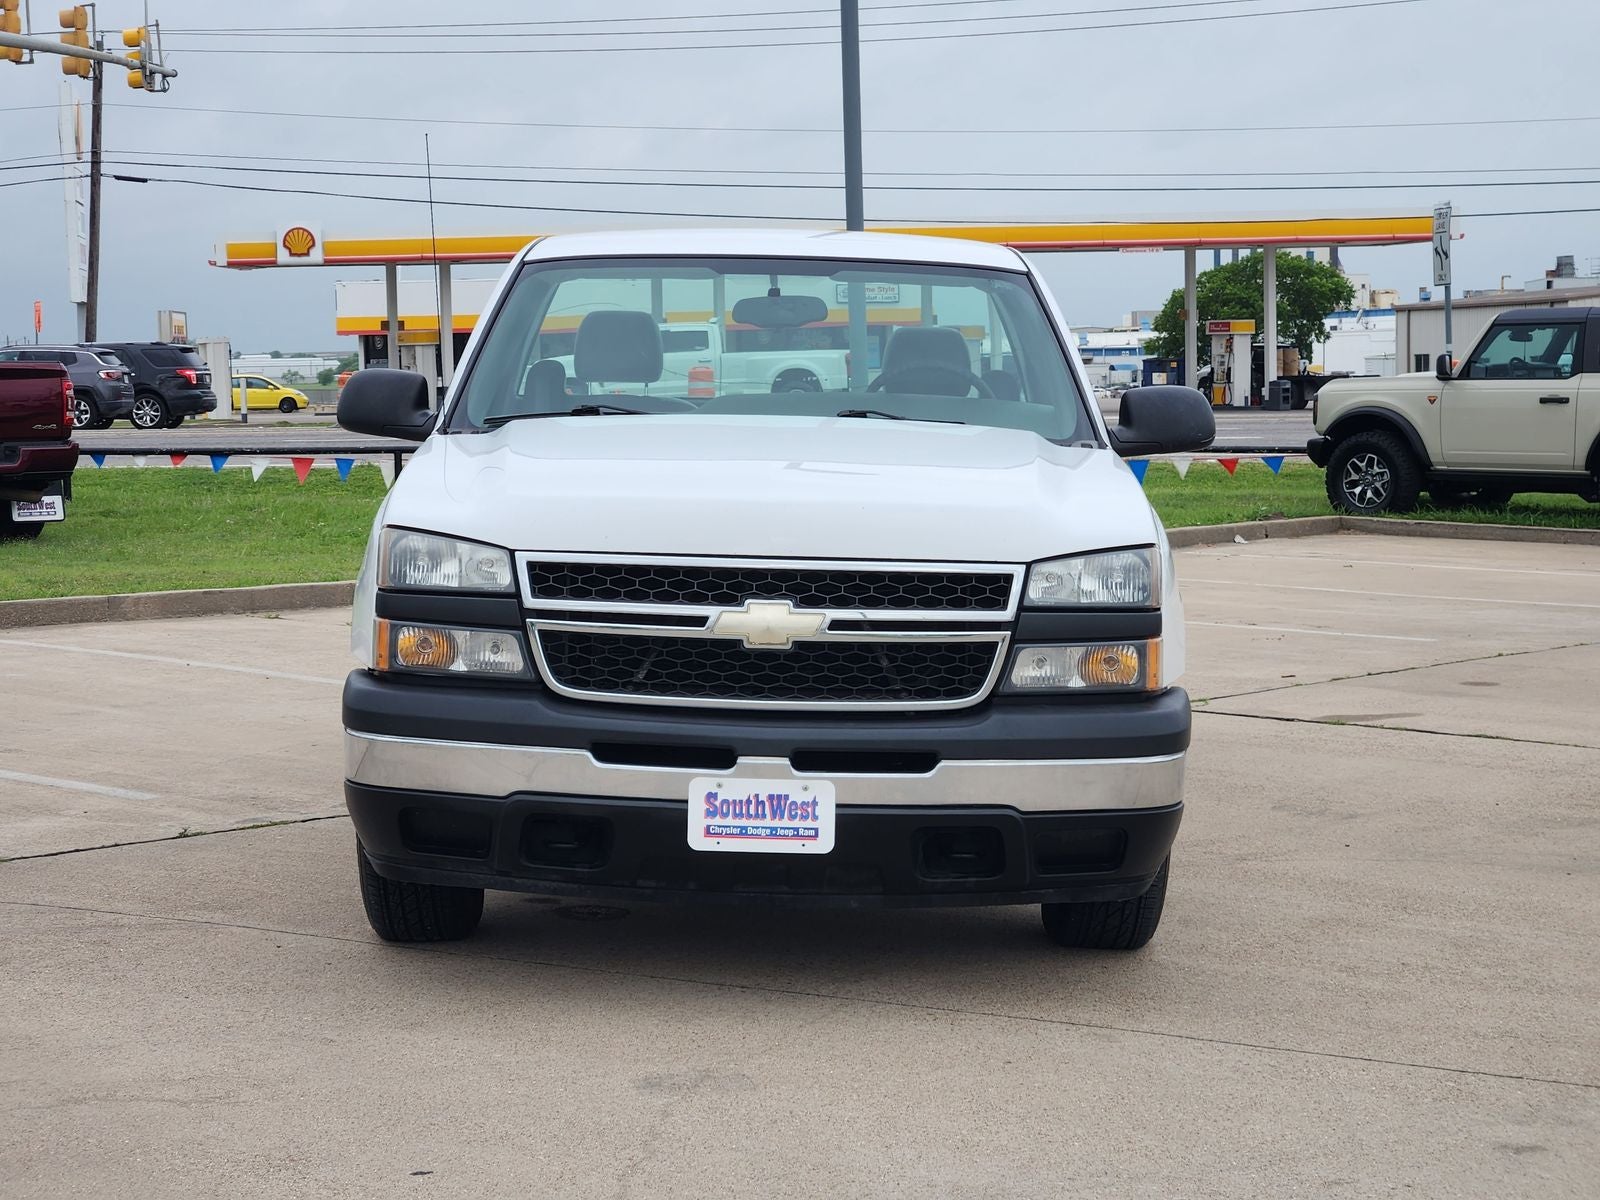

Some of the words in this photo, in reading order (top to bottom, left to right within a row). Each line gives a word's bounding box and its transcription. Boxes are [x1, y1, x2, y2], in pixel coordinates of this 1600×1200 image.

[704, 792, 819, 822] SouthWest
[709, 825, 741, 836] Chrysler
[747, 826, 771, 836] Dodge
[776, 827, 794, 837] Jeep
[798, 828, 815, 836] Ram
